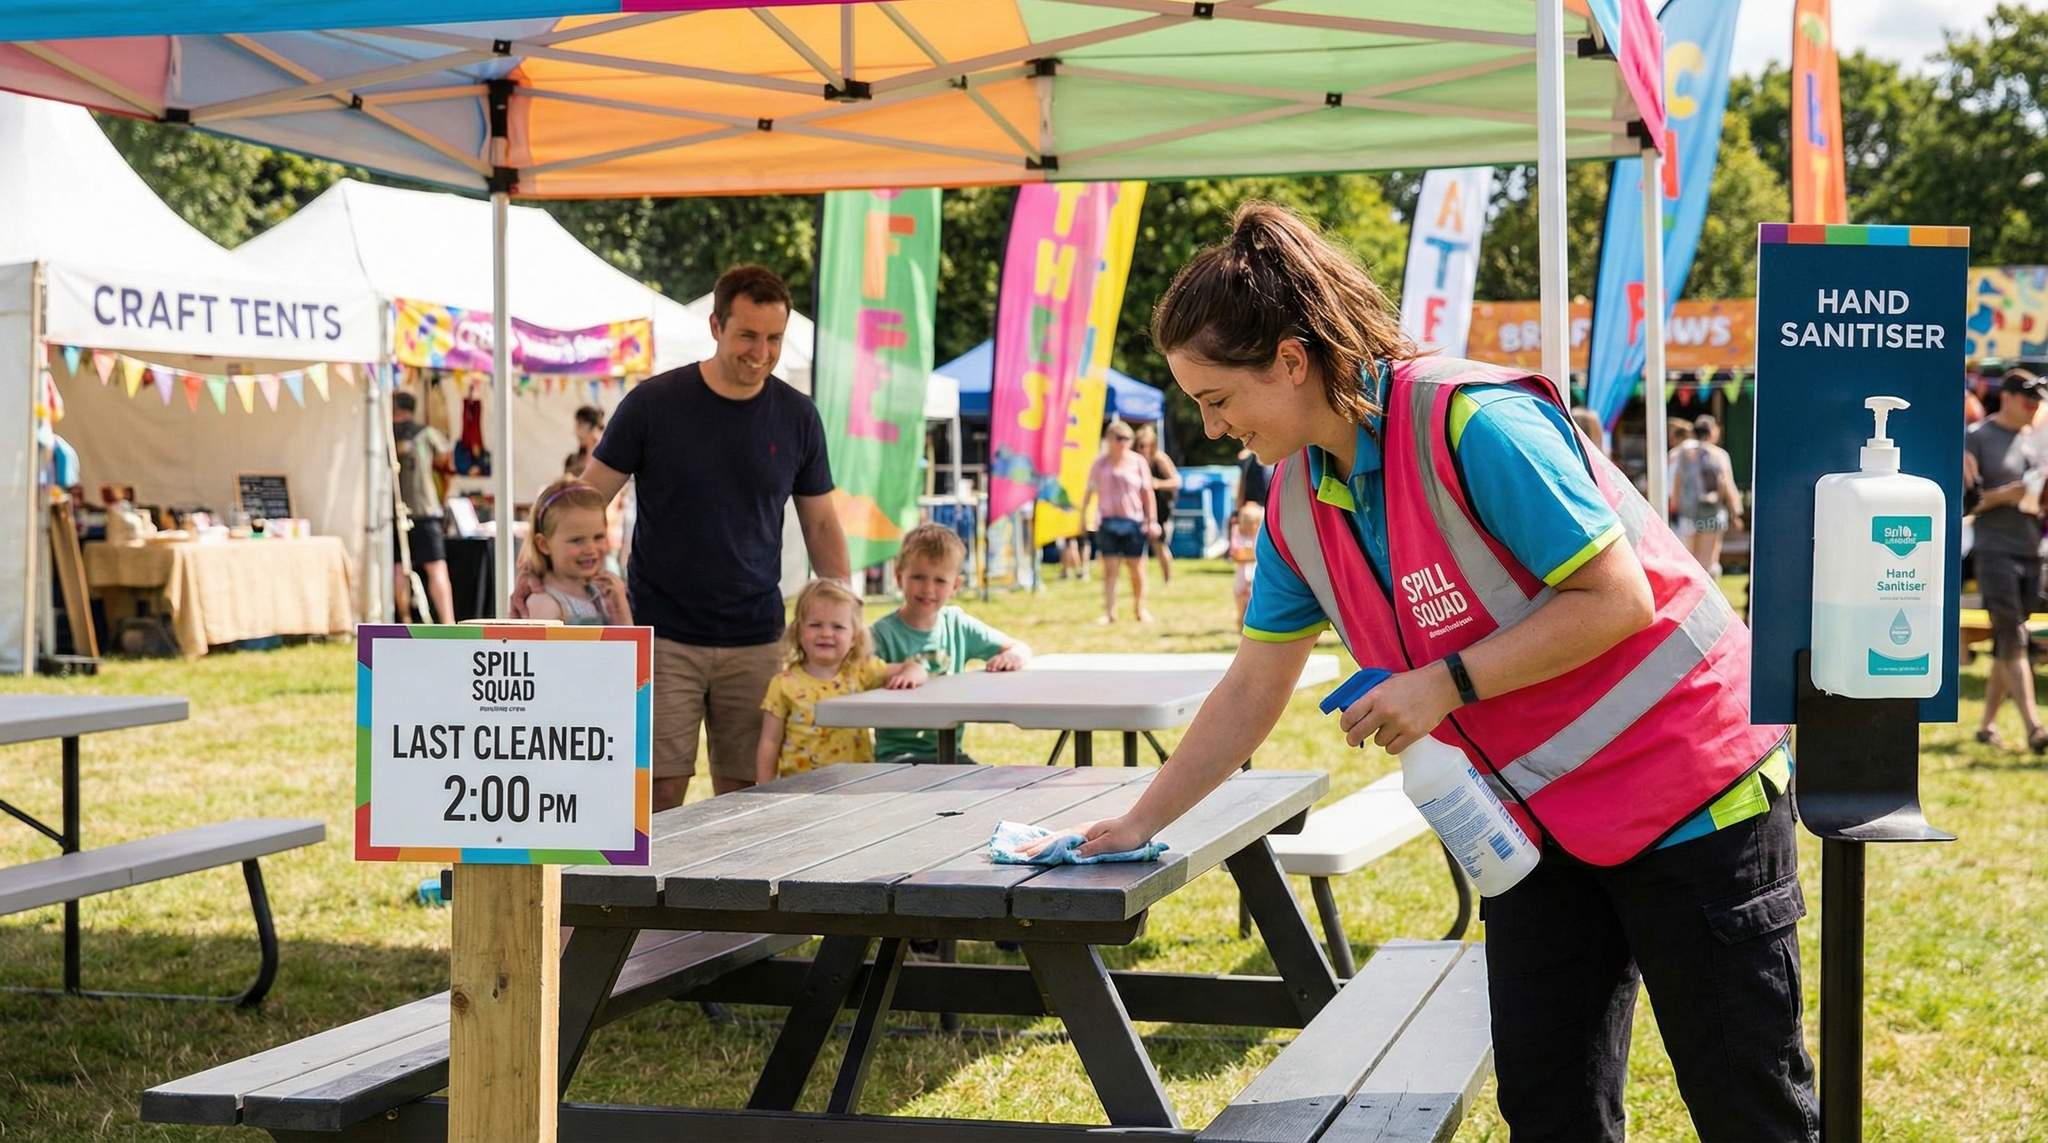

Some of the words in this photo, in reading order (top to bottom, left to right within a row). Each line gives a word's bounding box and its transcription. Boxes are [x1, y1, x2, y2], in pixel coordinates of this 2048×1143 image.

[94, 285, 218, 333] CRAFT
[230, 297, 342, 340] TENTS
[1818, 288, 1910, 315] HAND
[1780, 321, 1945, 349] SANITISER
[1401, 563, 1456, 603] SPILL
[1877, 581, 1927, 592] Sanitiser
[1886, 569, 1916, 579] Hand
[1411, 590, 1468, 629] SQUAD
[472, 651, 535, 677] SPILL
[472, 679, 535, 704] SQUAD
[393, 725, 465, 759] LAST
[473, 726, 614, 761] CLEANED:
[443, 774, 530, 823] 2:00
[539, 793, 577, 823] PM
